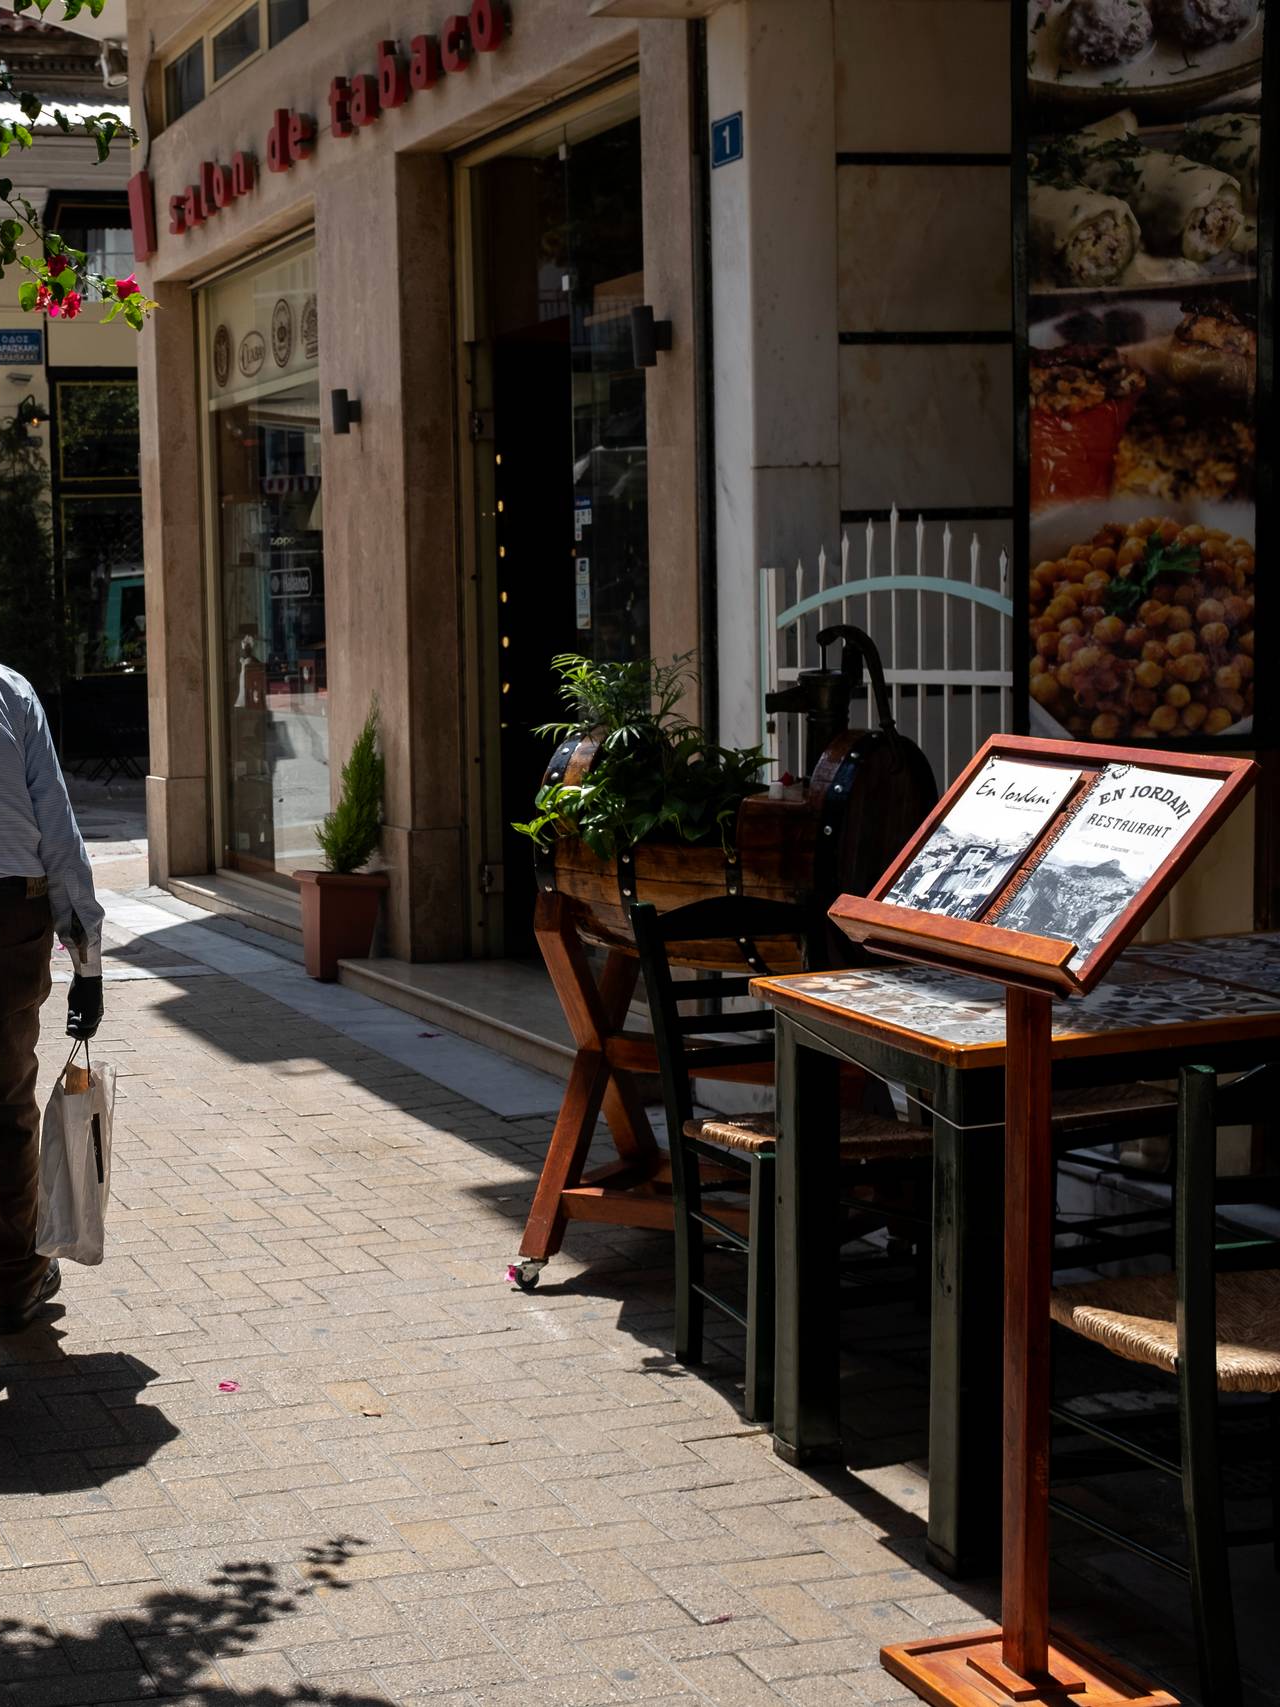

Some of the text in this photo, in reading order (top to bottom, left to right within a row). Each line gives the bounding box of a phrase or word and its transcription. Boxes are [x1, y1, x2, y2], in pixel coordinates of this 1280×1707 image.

[169, 0, 506, 235] salon de tabaco
[722, 125, 731, 154] 1
[1, 335, 29, 344] ΟΔΟΣ
[975, 777, 996, 797] En
[1098, 785, 1191, 821] EN IORDANI
[1086, 812, 1173, 840] RESTAURANT
